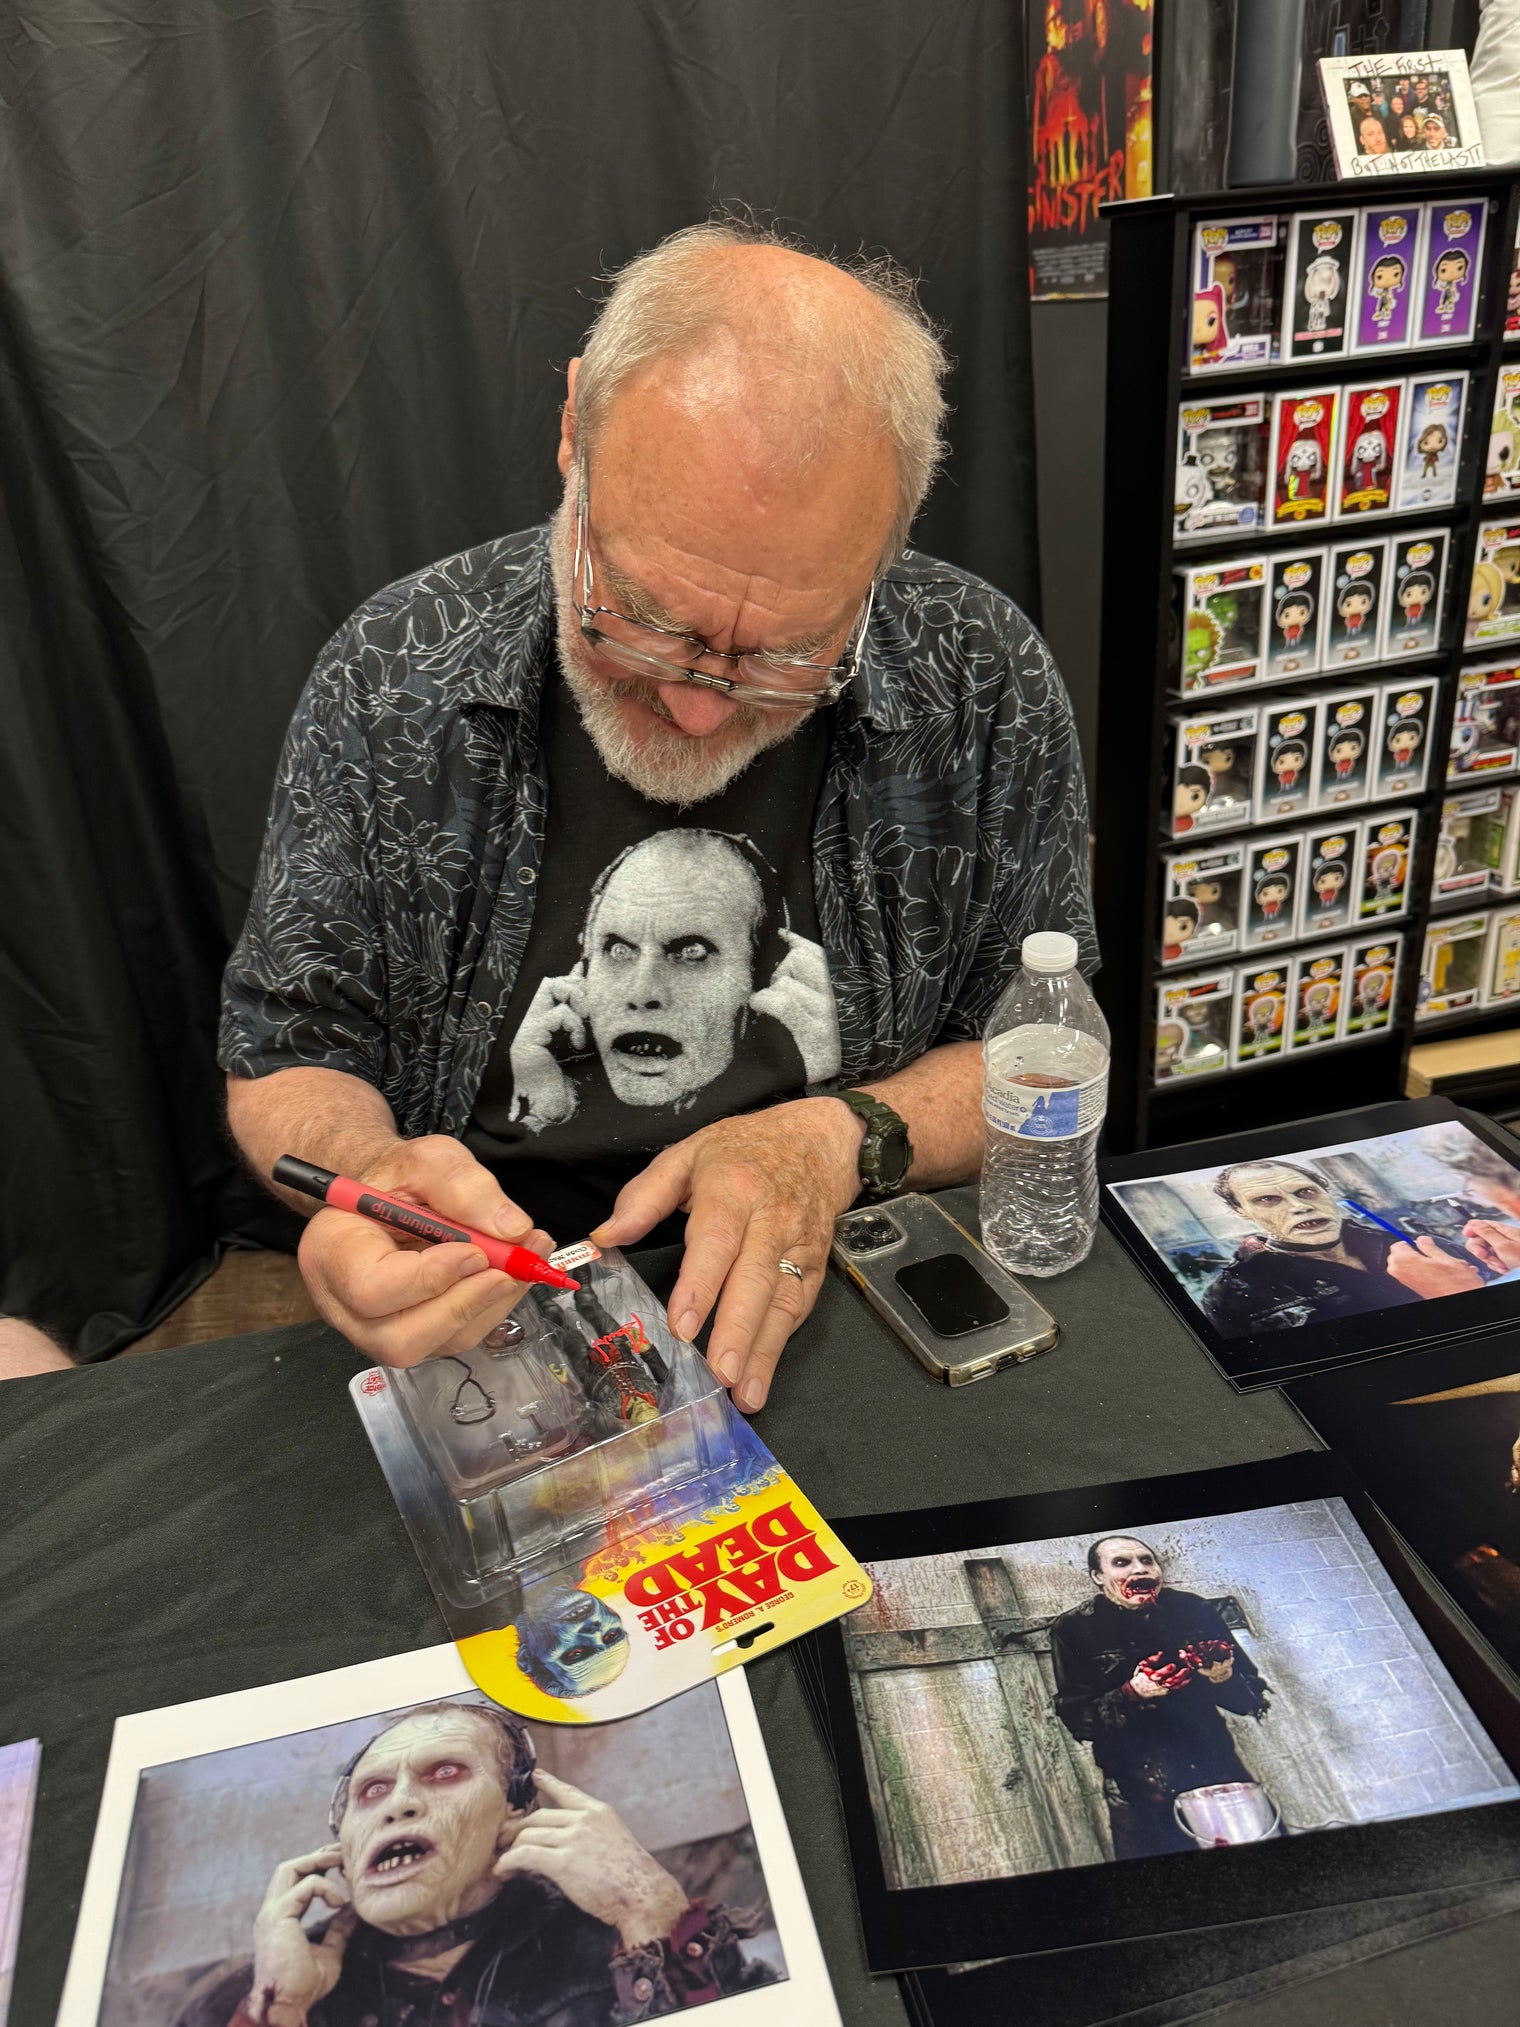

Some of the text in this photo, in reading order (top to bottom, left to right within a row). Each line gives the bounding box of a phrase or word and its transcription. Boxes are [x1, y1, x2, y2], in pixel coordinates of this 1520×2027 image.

[1348, 58, 1392, 77] THE
[371, 1201, 392, 1222] Tip
[398, 1213, 457, 1242] Medium
[624, 1501, 816, 1607] DEAD
[700, 1533, 840, 1631] DAY
[636, 1592, 703, 1632] THE
[715, 1591, 795, 1633] GEORGE A. ROMERO'S
[654, 1618, 695, 1650] OF
